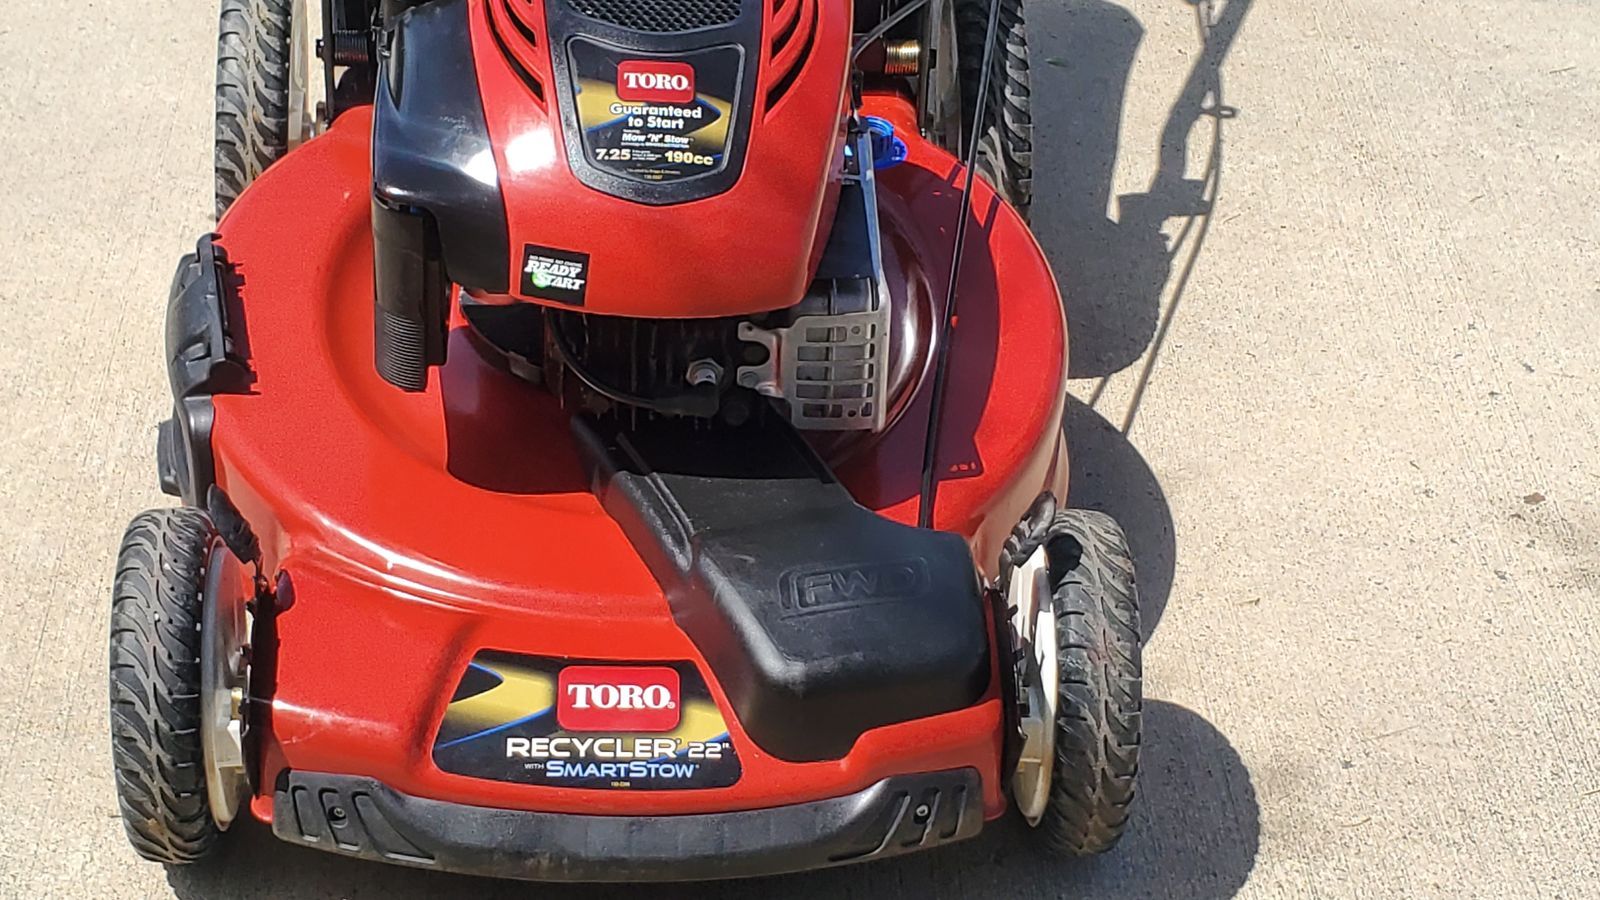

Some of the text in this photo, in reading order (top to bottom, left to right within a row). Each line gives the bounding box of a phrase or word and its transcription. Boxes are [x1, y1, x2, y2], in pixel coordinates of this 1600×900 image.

[624, 72, 689, 91] TORO
[610, 102, 702, 119] Guaranteed
[628, 116, 684, 129] to Start
[622, 133, 646, 142] Mow
[664, 135, 689, 144] Stow
[595, 148, 631, 160] 7.25
[664, 150, 714, 165] 190cc
[524, 260, 582, 278] READY
[536, 272, 585, 290] START
[568, 684, 673, 709] TORO
[505, 737, 730, 758] RECYCLER 22"
